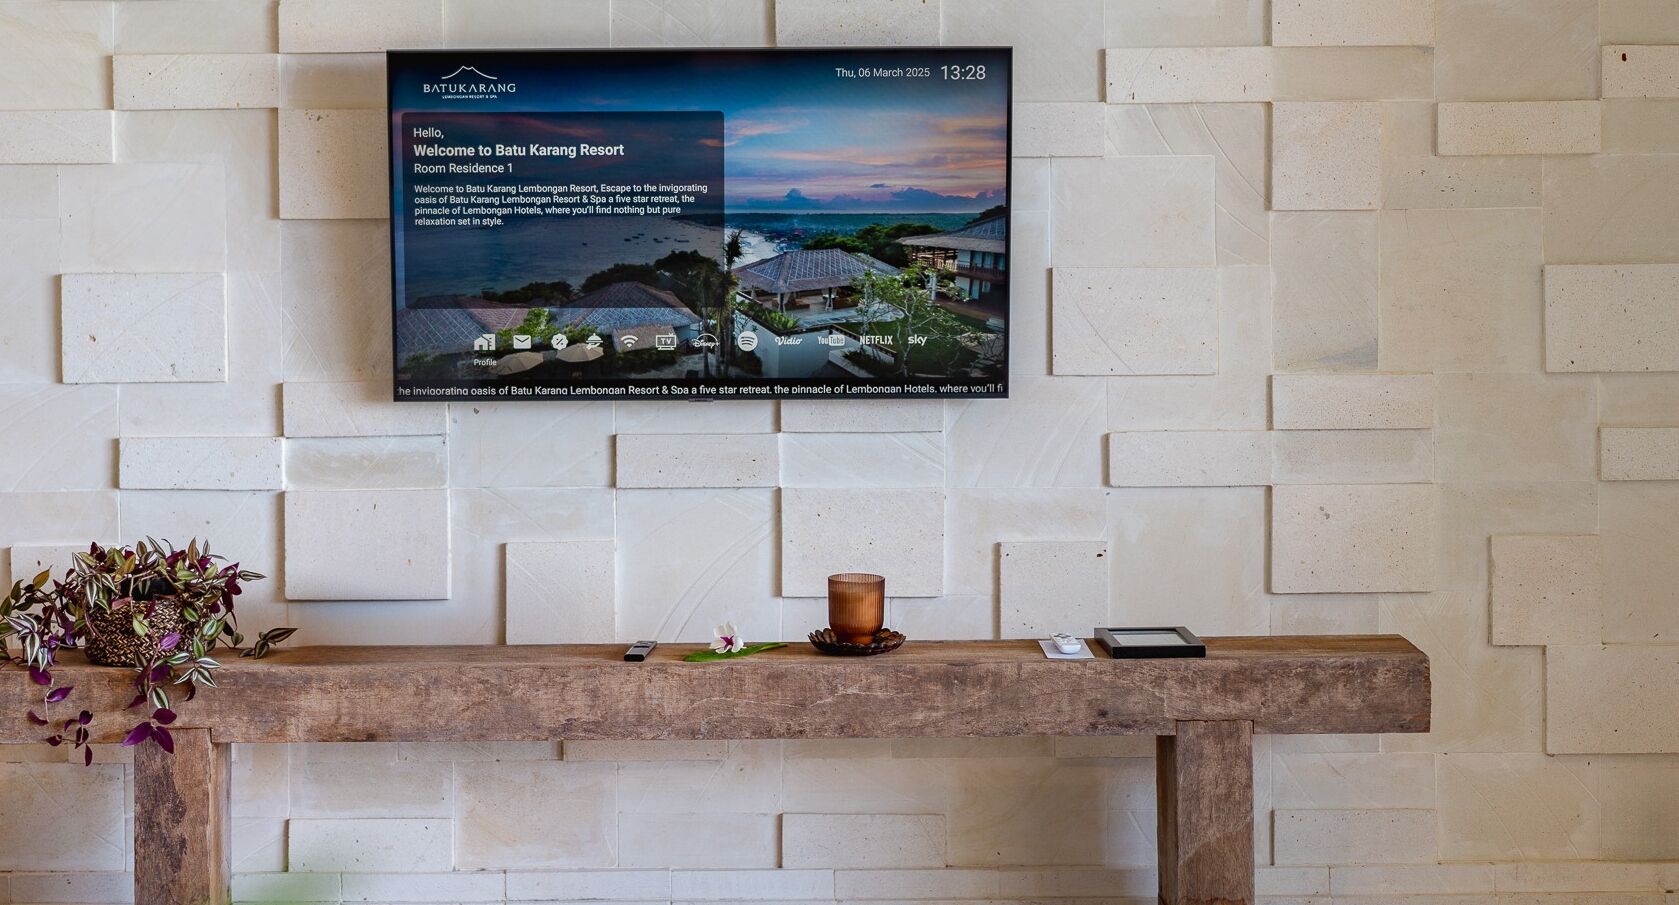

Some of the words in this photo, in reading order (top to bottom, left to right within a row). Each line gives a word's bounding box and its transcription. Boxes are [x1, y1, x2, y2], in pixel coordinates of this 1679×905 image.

[835, 67, 857, 79] Thu,
[858, 67, 871, 78] 06
[873, 67, 903, 78] March
[905, 67, 931, 78] 2025
[940, 65, 986, 80] 13:28
[423, 83, 516, 93] BATUKARANG
[413, 127, 444, 139] Hello,
[414, 144, 475, 157] Welcome
[478, 145, 492, 156] to
[496, 144, 526, 156] Batu
[529, 143, 577, 158] Karang
[580, 143, 625, 156] Resort
[414, 163, 446, 173] Room
[449, 163, 504, 173] Residence
[507, 163, 513, 172] 1
[414, 185, 454, 193] Welcome
[466, 185, 485, 193] Batu
[487, 185, 517, 195] Karang
[518, 185, 568, 195] Lembongan
[569, 184, 599, 194] Resort,
[600, 184, 631, 194] Escape
[633, 184, 642, 192] to
[643, 184, 657, 192] the
[659, 183, 708, 194] invigorating
[414, 196, 437, 204] oasis
[438, 195, 448, 204] of
[450, 196, 469, 204] Batu
[470, 195, 500, 205] Karang
[502, 195, 551, 205] Lembongan
[553, 195, 580, 203] Resort
[582, 195, 589, 203] &
[590, 195, 606, 205] Spa
[615, 195, 631, 203] five
[633, 195, 649, 203] star
[650, 195, 680, 204] retreat,
[681, 195, 695, 203] the
[414, 206, 450, 216] pinnacle
[451, 206, 461, 215] of
[462, 206, 512, 216] Lembongan
[514, 206, 543, 216] Hotels,
[545, 206, 571, 214] where
[572, 205, 594, 216] you'll
[595, 205, 612, 214] find
[614, 205, 645, 215] nothing
[647, 205, 661, 214] but
[662, 206, 682, 215] pure
[414, 217, 456, 226] relaxation
[472, 217, 480, 225] in
[482, 217, 504, 227] style.
[660, 337, 673, 345] TV
[774, 335, 803, 346] Vidio
[817, 334, 845, 346] YouTube
[859, 335, 894, 345] NETFLIX
[907, 334, 928, 347] sky
[473, 358, 497, 366] Profile
[397, 386, 411, 396] he
[413, 386, 469, 396] invigorating
[471, 386, 496, 395] oasis
[498, 386, 509, 395] of
[511, 386, 533, 395] Batu
[535, 386, 568, 395] Karang
[570, 386, 627, 395] Lembongan
[628, 385, 660, 395] Resort
[661, 385, 669, 394] &
[671, 385, 689, 395] Spa
[700, 385, 717, 394] five
[719, 385, 737, 394] star
[774, 385, 790, 394] the
[791, 385, 832, 394] pinnacle
[834, 385, 844, 394] of
[846, 384, 901, 394] Lembongan
[939, 384, 968, 393] where
